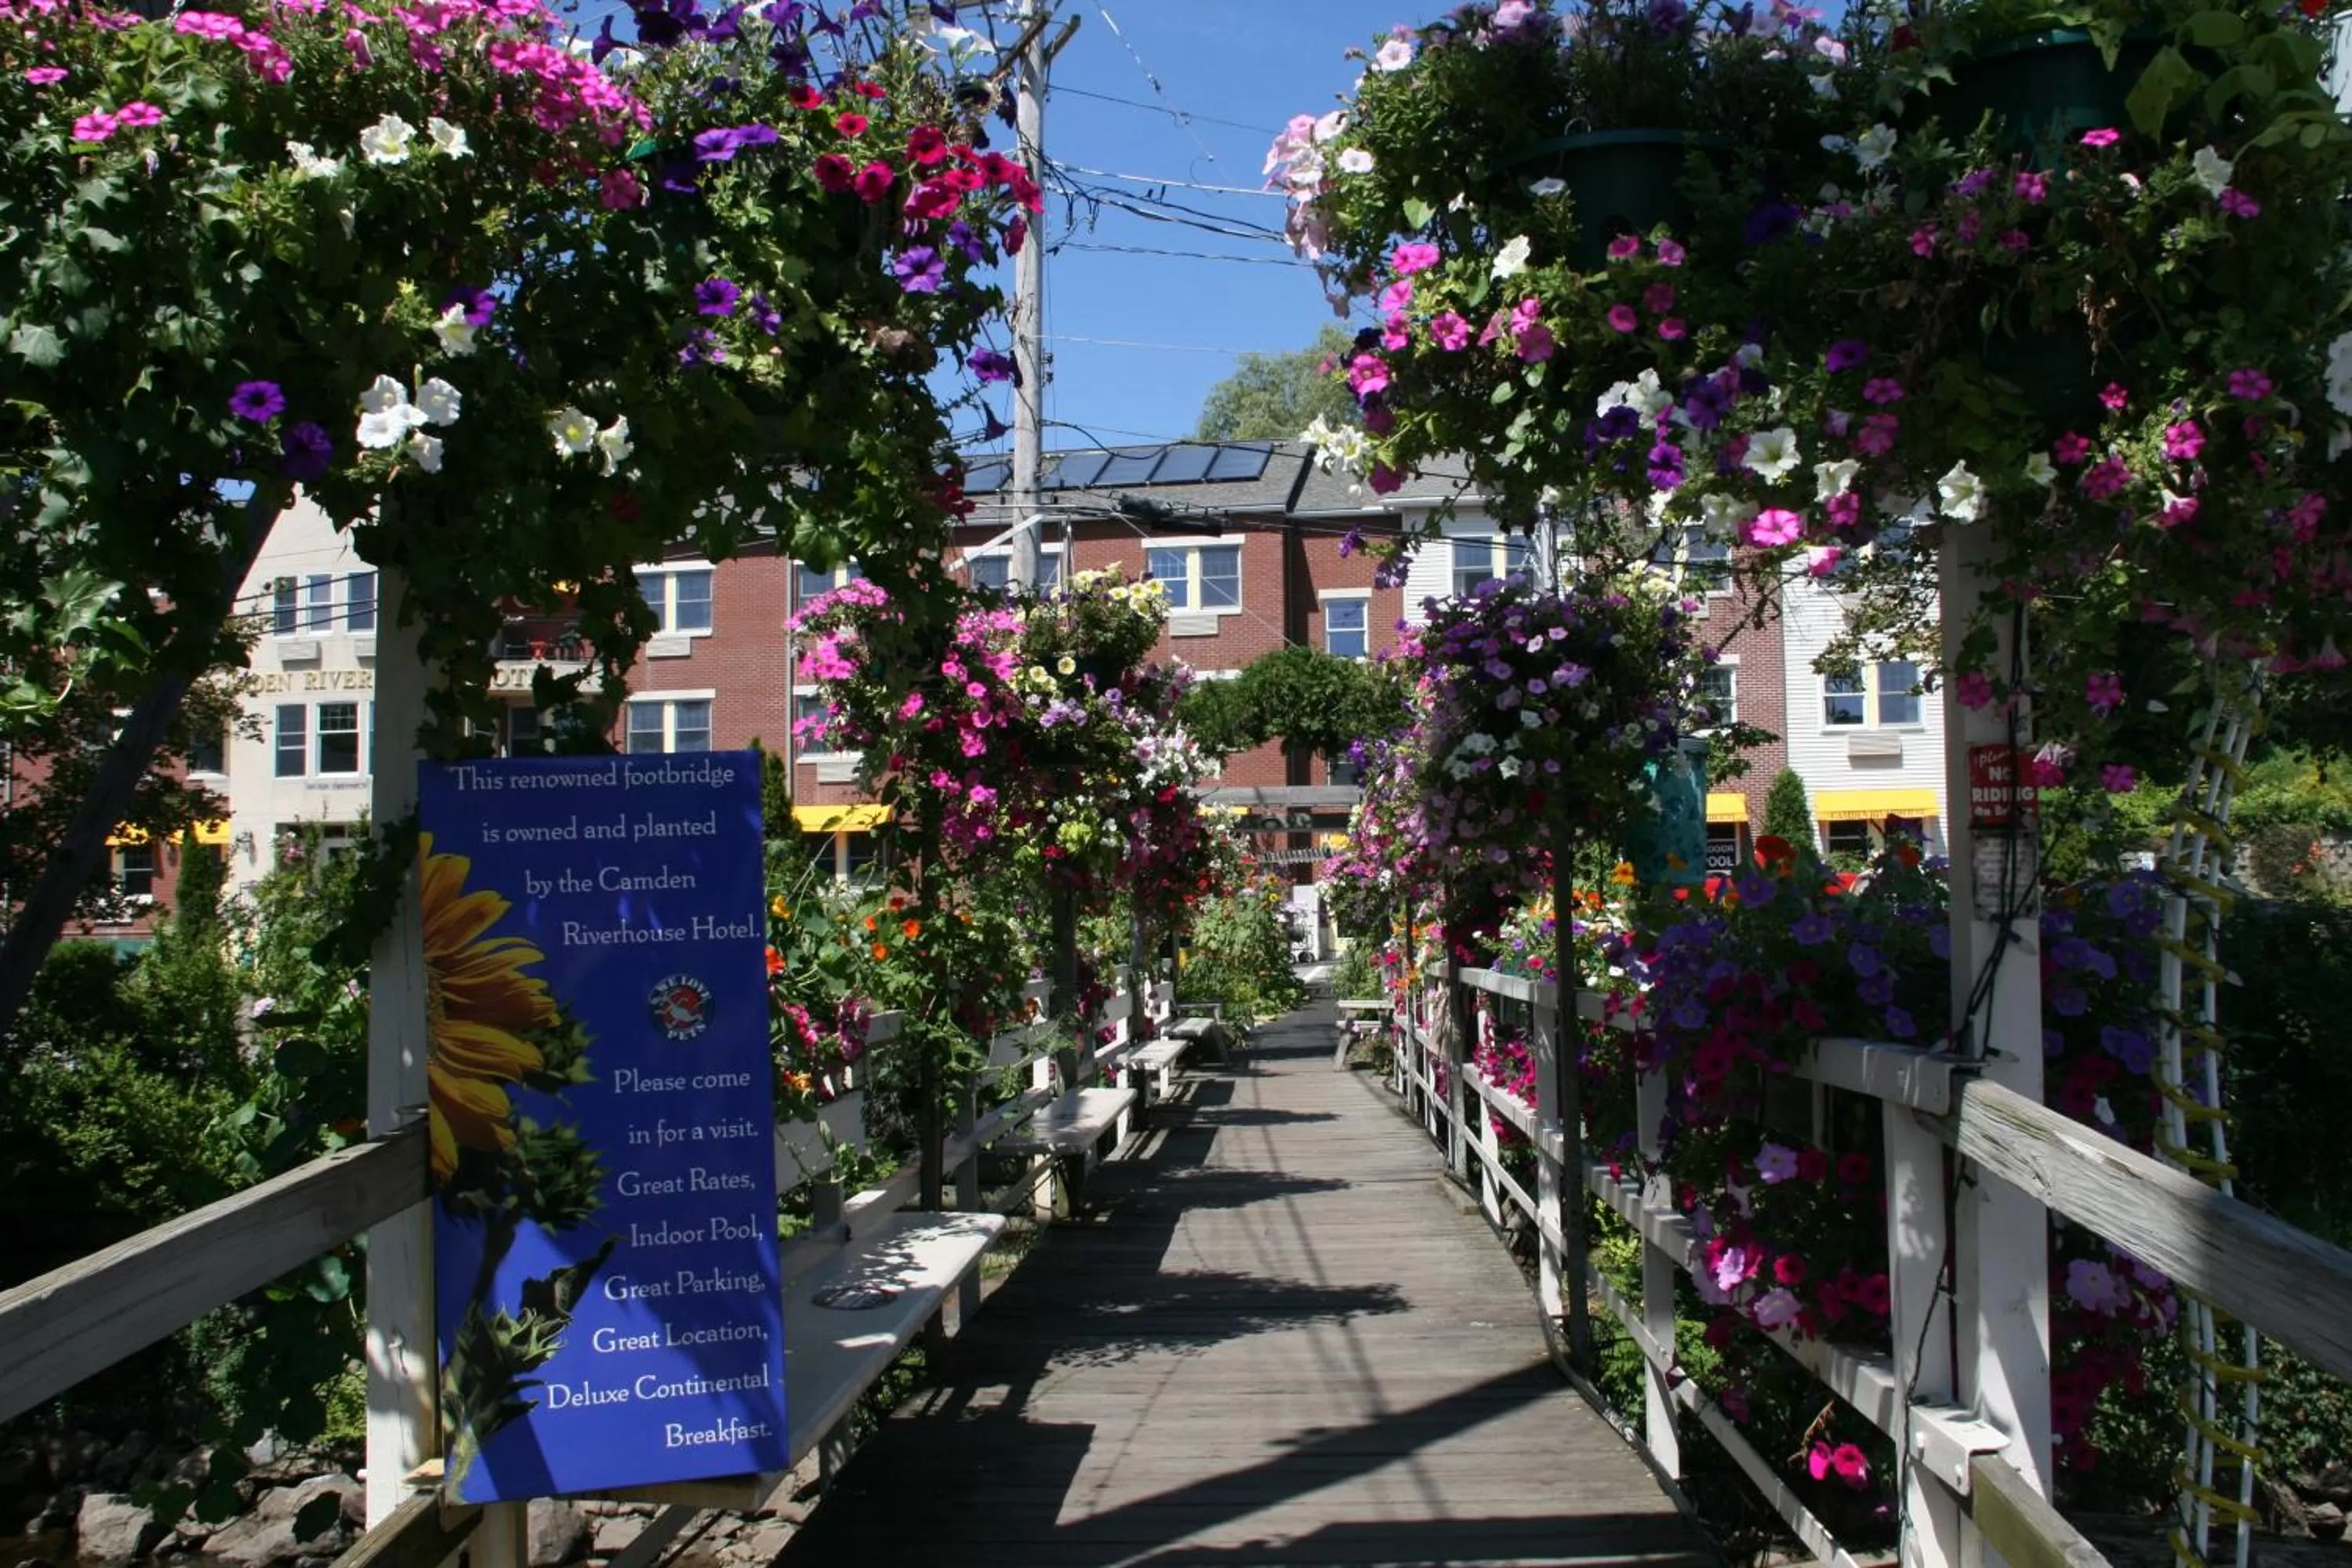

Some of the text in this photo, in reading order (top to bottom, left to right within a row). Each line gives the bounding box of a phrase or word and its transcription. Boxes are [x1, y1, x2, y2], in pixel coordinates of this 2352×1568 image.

[448, 759, 735, 790] This renowned footbridge
[483, 810, 716, 842] is owned and planted
[1706, 855, 1734, 867] OOL
[525, 866, 695, 898] by the Camden
[563, 913, 760, 946] Riverhouse Hotel.
[615, 1068, 750, 1093] Please come
[629, 1117, 758, 1148] in for a visit.
[618, 1167, 755, 1196] Great Rates,
[630, 1214, 763, 1247] Indoor Pool,
[604, 1267, 765, 1302] Great Parking,
[592, 1321, 768, 1353] Great Location,
[546, 1364, 770, 1409] Deluxe Continental
[665, 1417, 772, 1449] Breakfast.
